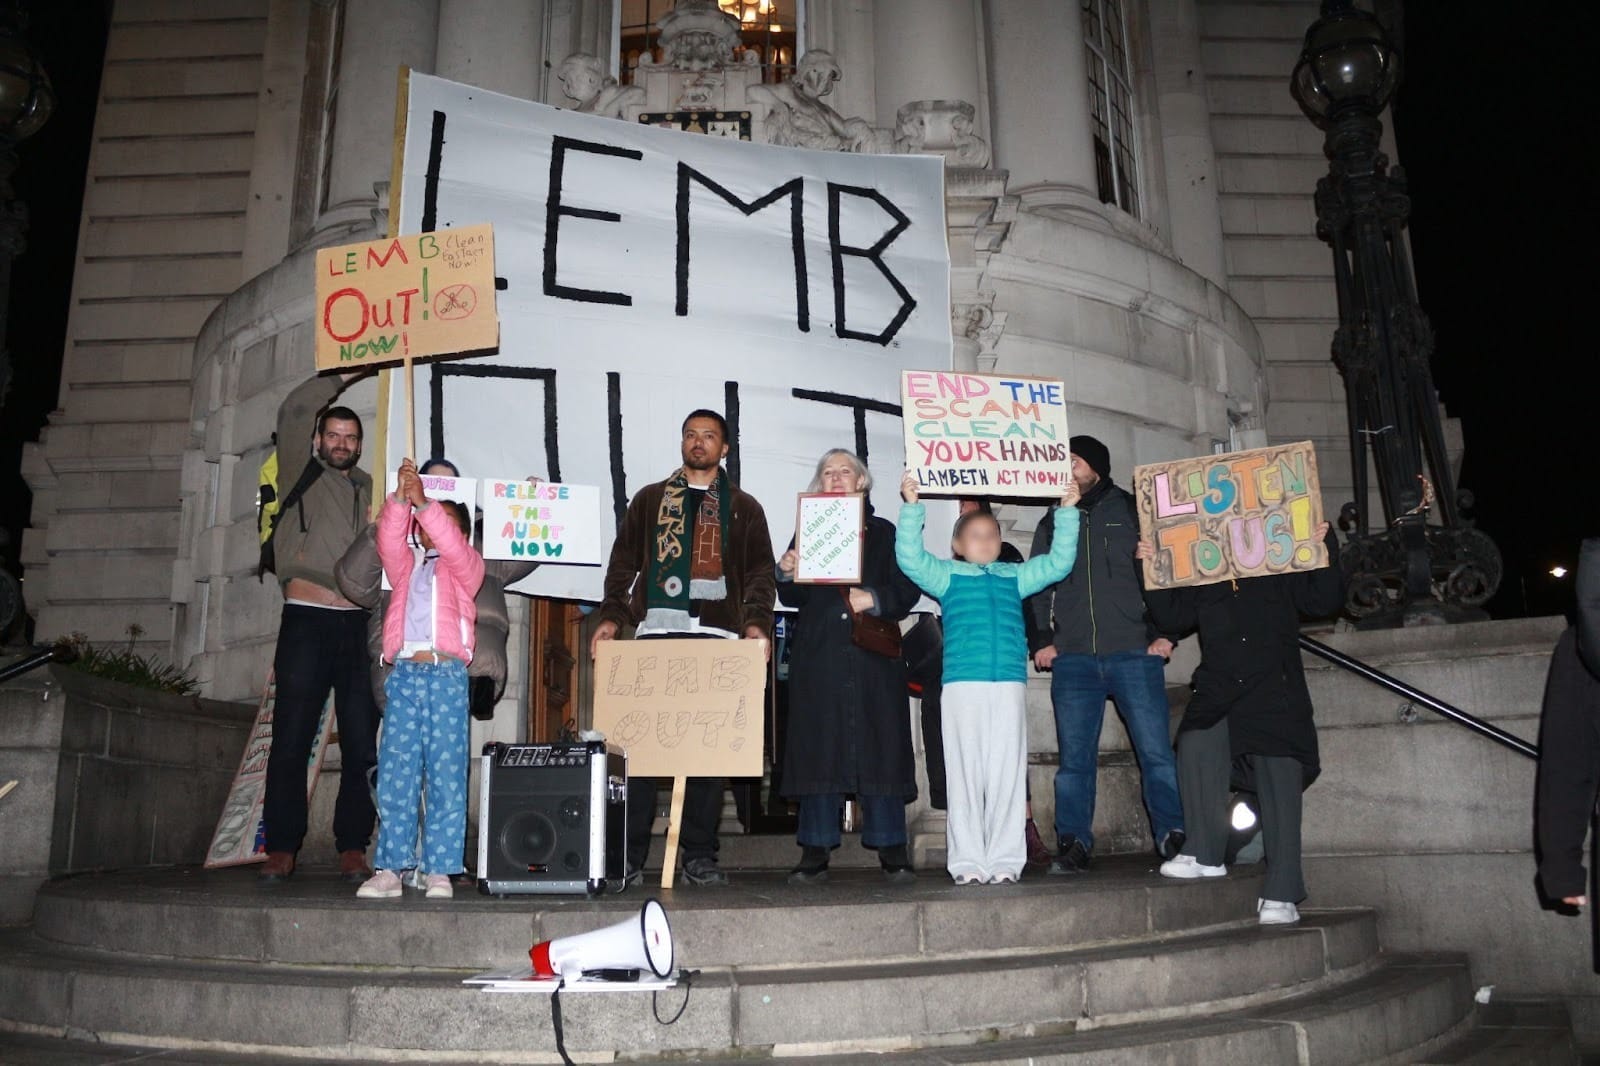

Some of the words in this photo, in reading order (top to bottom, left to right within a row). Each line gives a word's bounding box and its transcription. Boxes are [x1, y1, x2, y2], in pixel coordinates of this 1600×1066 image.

[330, 235, 440, 276] LEMB
[340, 331, 409, 361] NOW!
[907, 372, 990, 399] END
[1000, 382, 1063, 406] THE
[914, 398, 1041, 421] SCAM
[913, 420, 1057, 440] CLEAN
[915, 440, 999, 466] YOUR
[999, 439, 1066, 463] HANDS
[494, 482, 570, 500] RELEASE
[916, 468, 989, 487] LAMBETH
[1025, 470, 1070, 487] NOW!!
[508, 505, 552, 520] THE
[802, 515, 826, 537] LEMB
[824, 499, 842, 517] OUT
[501, 521, 565, 540] AUDIT
[802, 539, 825, 561] LEMB
[823, 522, 842, 540] OUT
[1230, 495, 1312, 570] US!
[511, 540, 563, 557] NOW
[818, 546, 842, 568] LEMB
[840, 530, 858, 548] OUT
[607, 654, 750, 698] LEMB
[613, 695, 748, 752] OUT!
